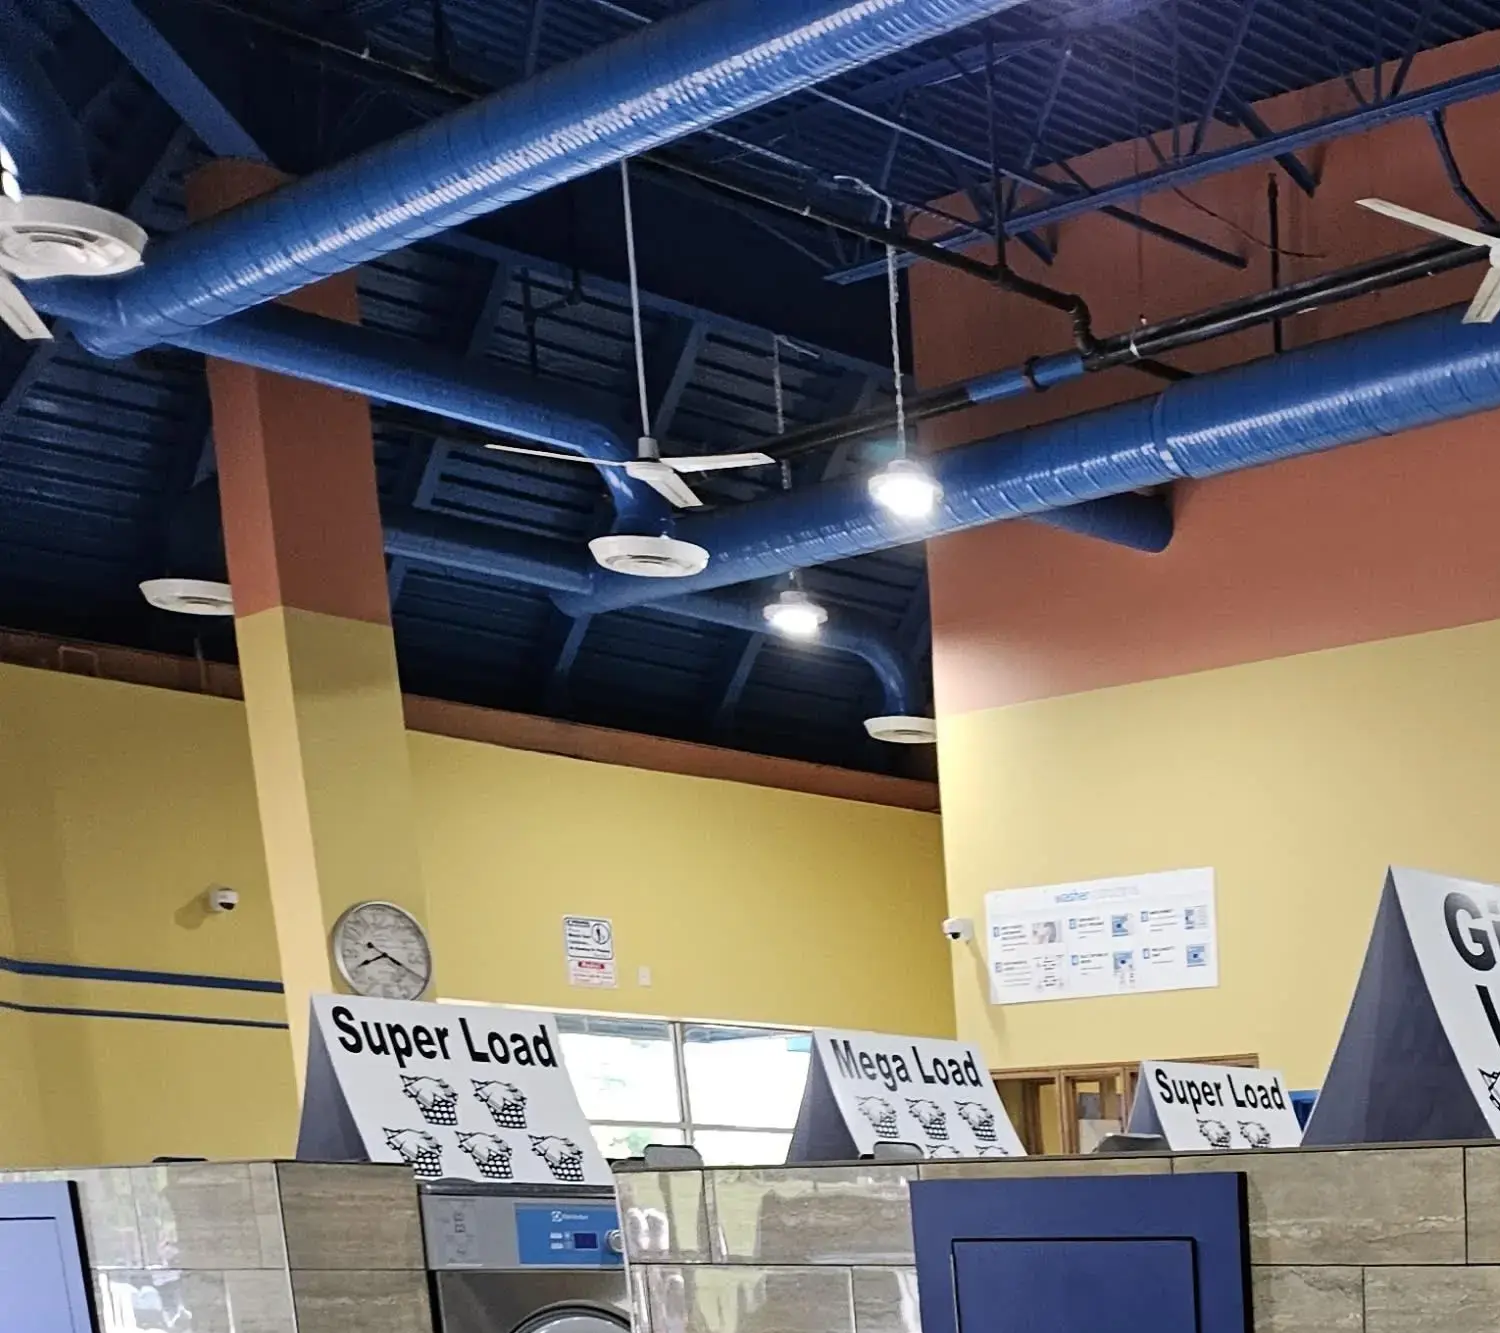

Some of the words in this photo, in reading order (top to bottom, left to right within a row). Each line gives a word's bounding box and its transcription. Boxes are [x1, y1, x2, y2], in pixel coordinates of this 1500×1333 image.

[331, 1005, 451, 1069] Super
[458, 1016, 559, 1068] Load
[829, 1038, 912, 1092] Mega
[911, 1045, 984, 1088] Load
[1154, 1067, 1225, 1115] Super
[1226, 1073, 1288, 1111] Load
